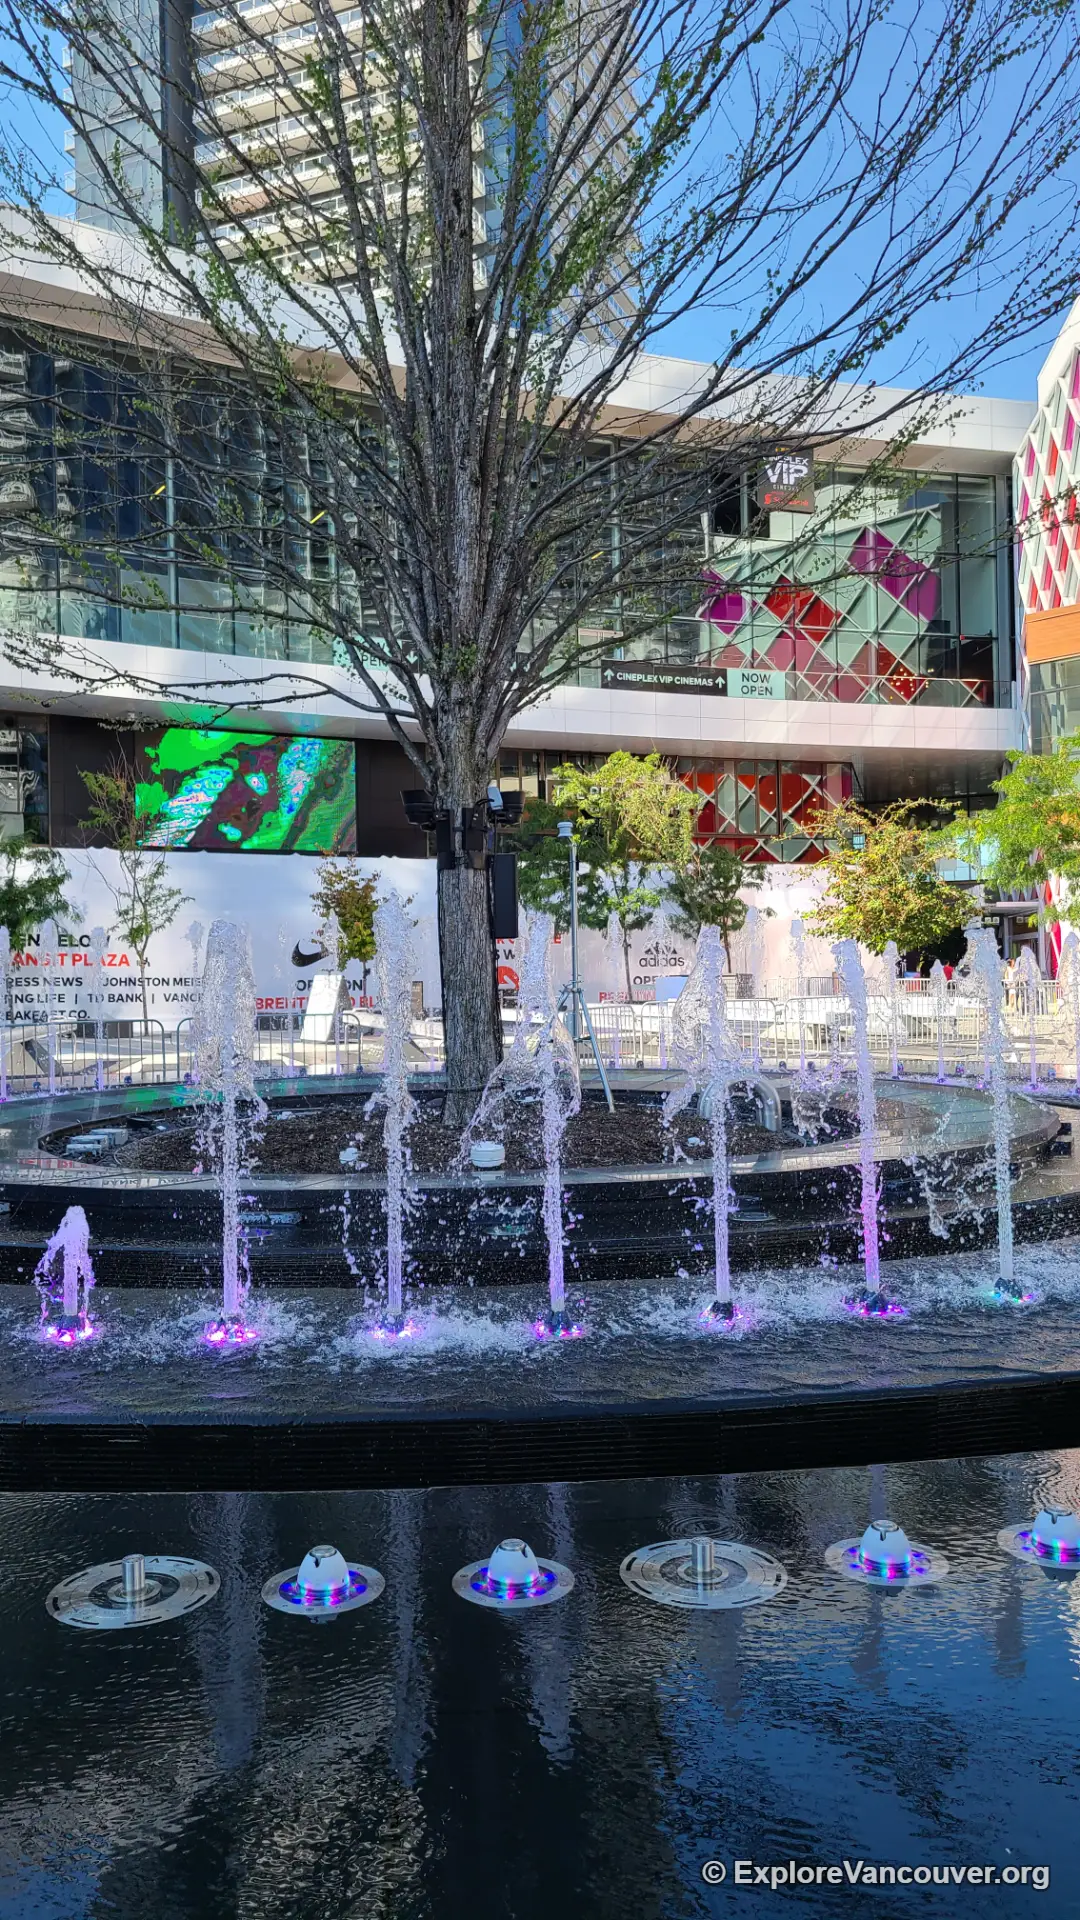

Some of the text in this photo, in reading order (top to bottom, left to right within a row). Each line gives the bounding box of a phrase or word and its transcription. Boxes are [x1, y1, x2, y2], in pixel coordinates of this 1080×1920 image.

[765, 462, 808, 485] VIP
[616, 671, 713, 687] CINEPLEX VIP CINEMAS
[741, 673, 771, 684] NOW
[740, 685, 773, 696] OPEN
[639, 955, 685, 967] adidas
[103, 977, 170, 987] JOHNSTON
[107, 993, 143, 1003] BANK
